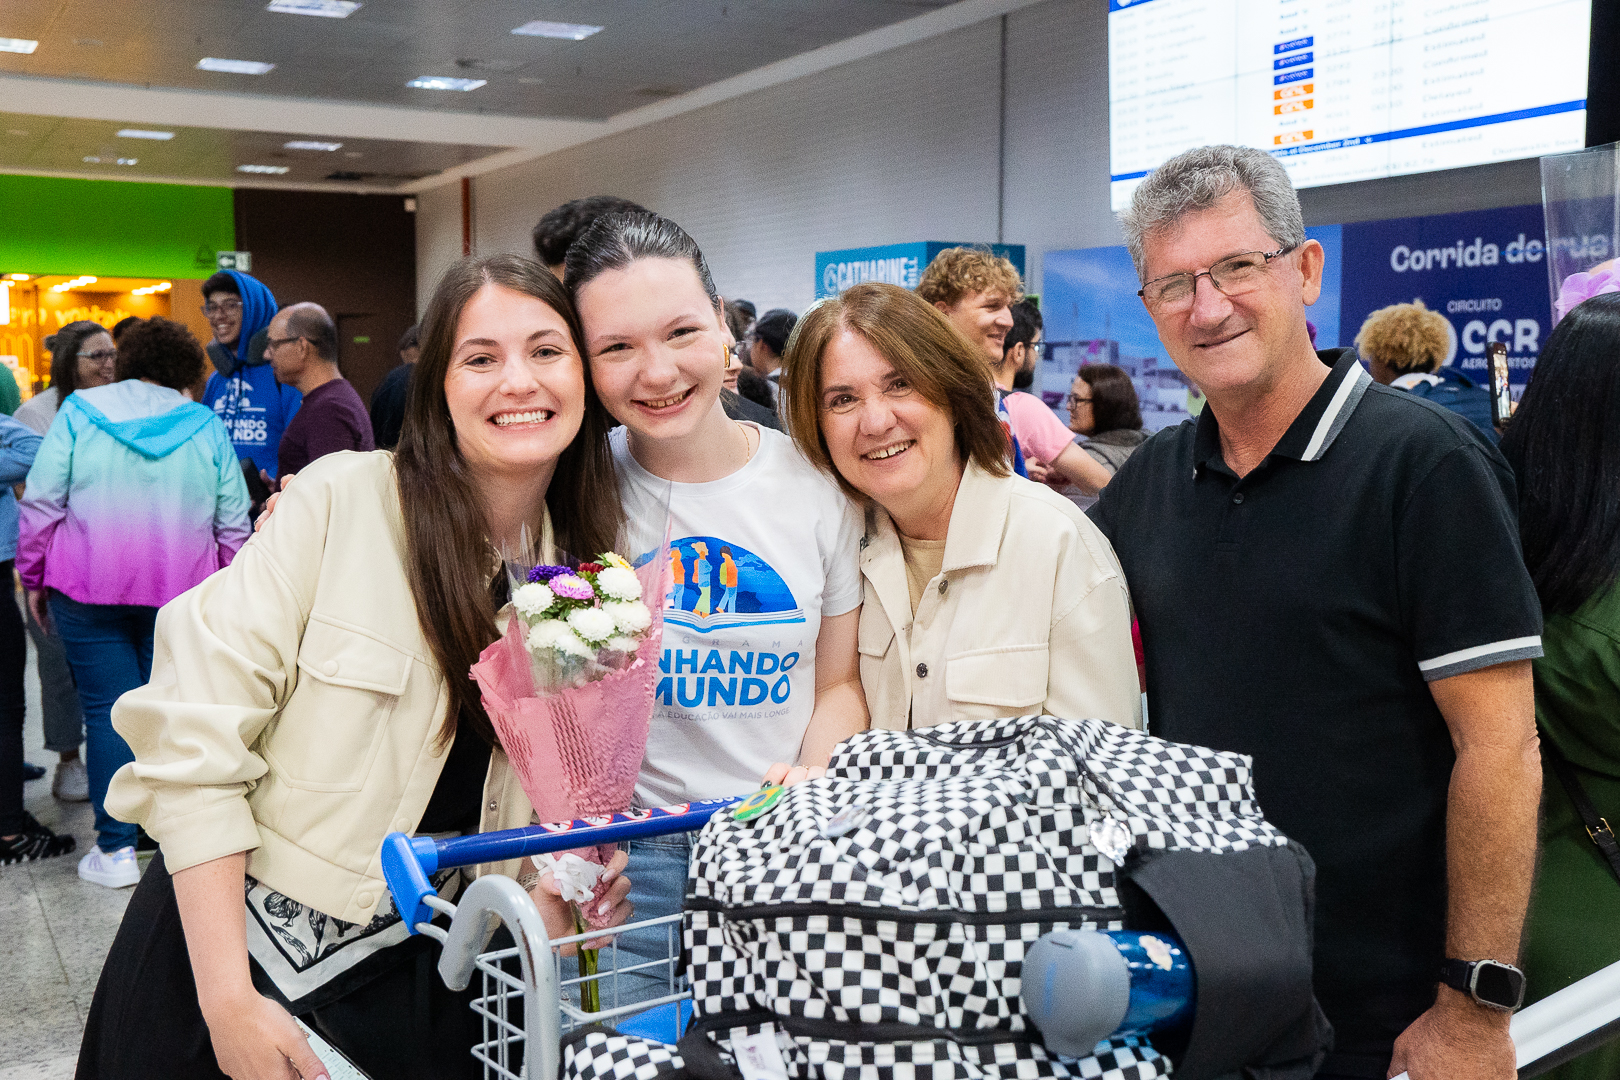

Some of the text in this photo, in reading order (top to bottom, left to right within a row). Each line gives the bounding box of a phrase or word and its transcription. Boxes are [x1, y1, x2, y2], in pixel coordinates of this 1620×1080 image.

[1390, 237, 1499, 272] Corrida
[1505, 233, 1543, 264] de
[837, 257, 908, 292] CATHARINE
[1446, 298, 1503, 314] CIRCUITO
[1461, 318, 1540, 354] CCR
[658, 648, 800, 676] NHANDO
[667, 709, 720, 722] EDUCAÇÃO
[722, 711, 737, 720] VAI
[740, 711, 762, 720] MAIS
[764, 707, 791, 719] LONGE
